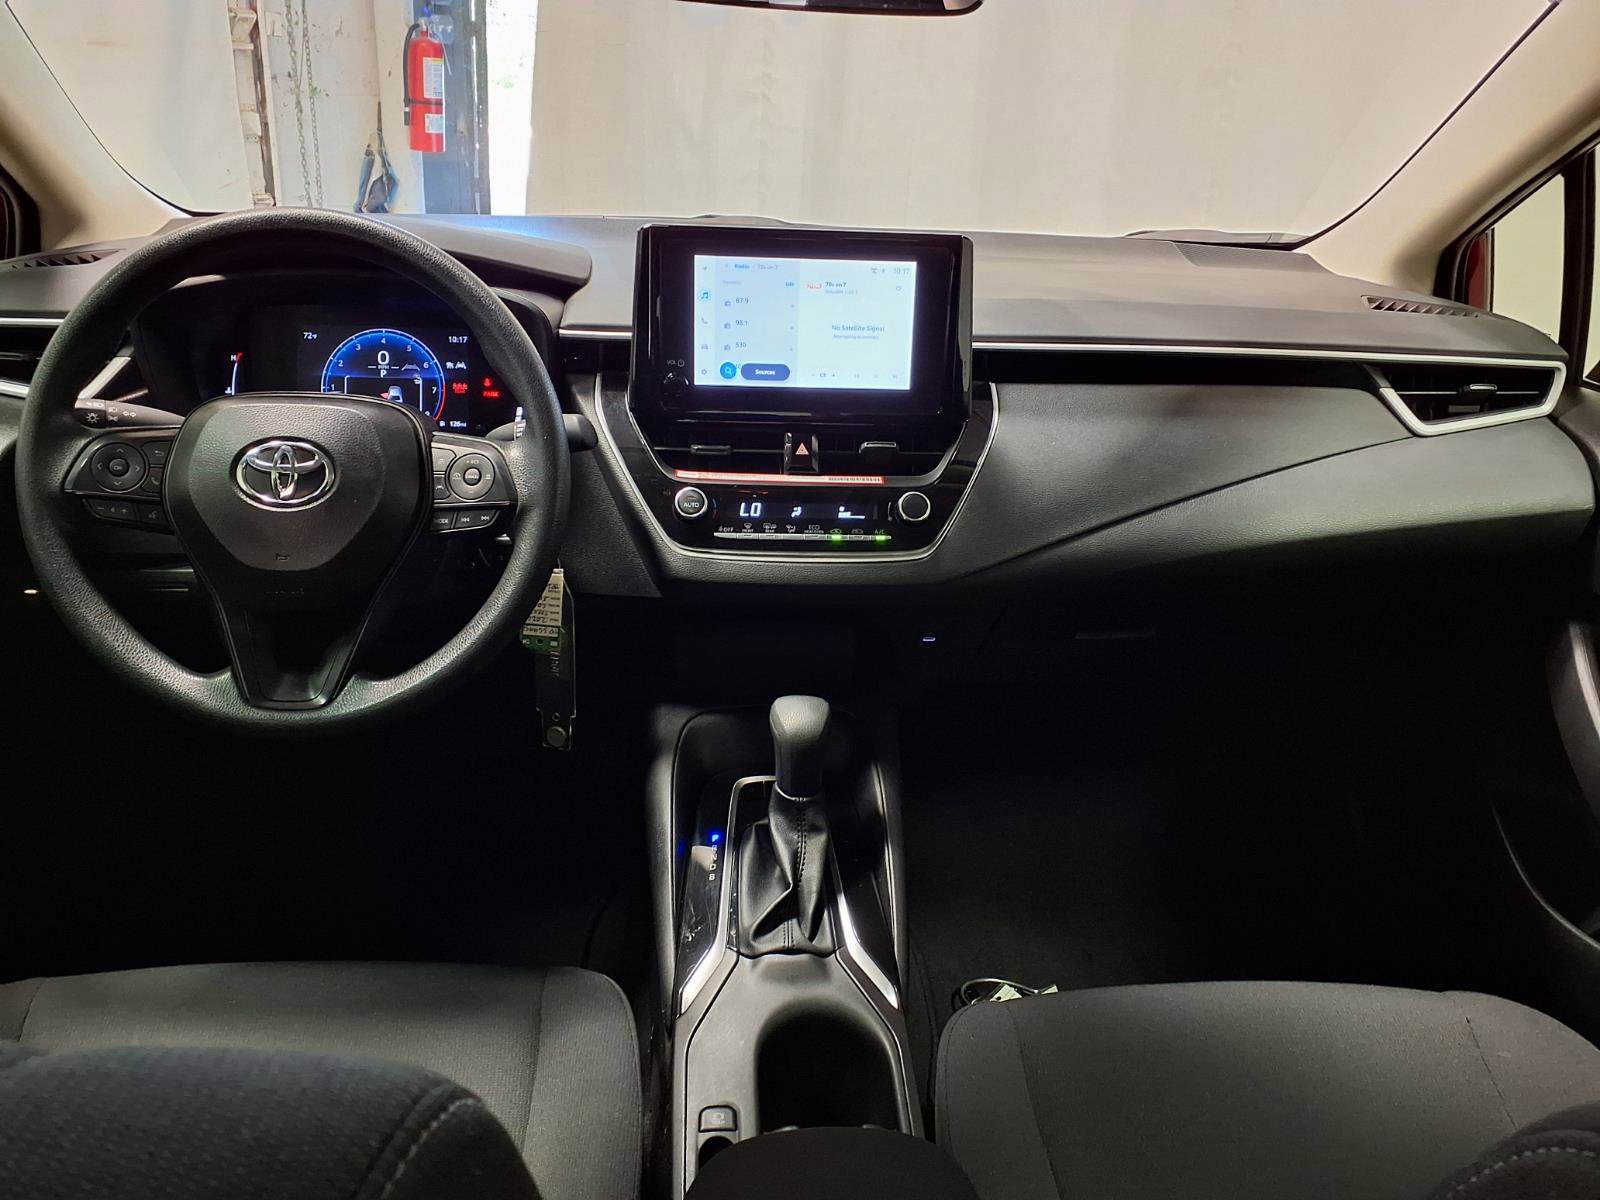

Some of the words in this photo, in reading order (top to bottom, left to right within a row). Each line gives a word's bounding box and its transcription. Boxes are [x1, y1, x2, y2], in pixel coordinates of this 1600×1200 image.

[841, 324, 866, 332] Satellite
[448, 336, 468, 344] 10:17
[377, 350, 390, 365] 0
[423, 361, 429, 369] 6
[380, 369, 387, 378] P
[754, 368, 776, 376] Sources
[739, 502, 762, 517] LO
[712, 834, 719, 842] P
